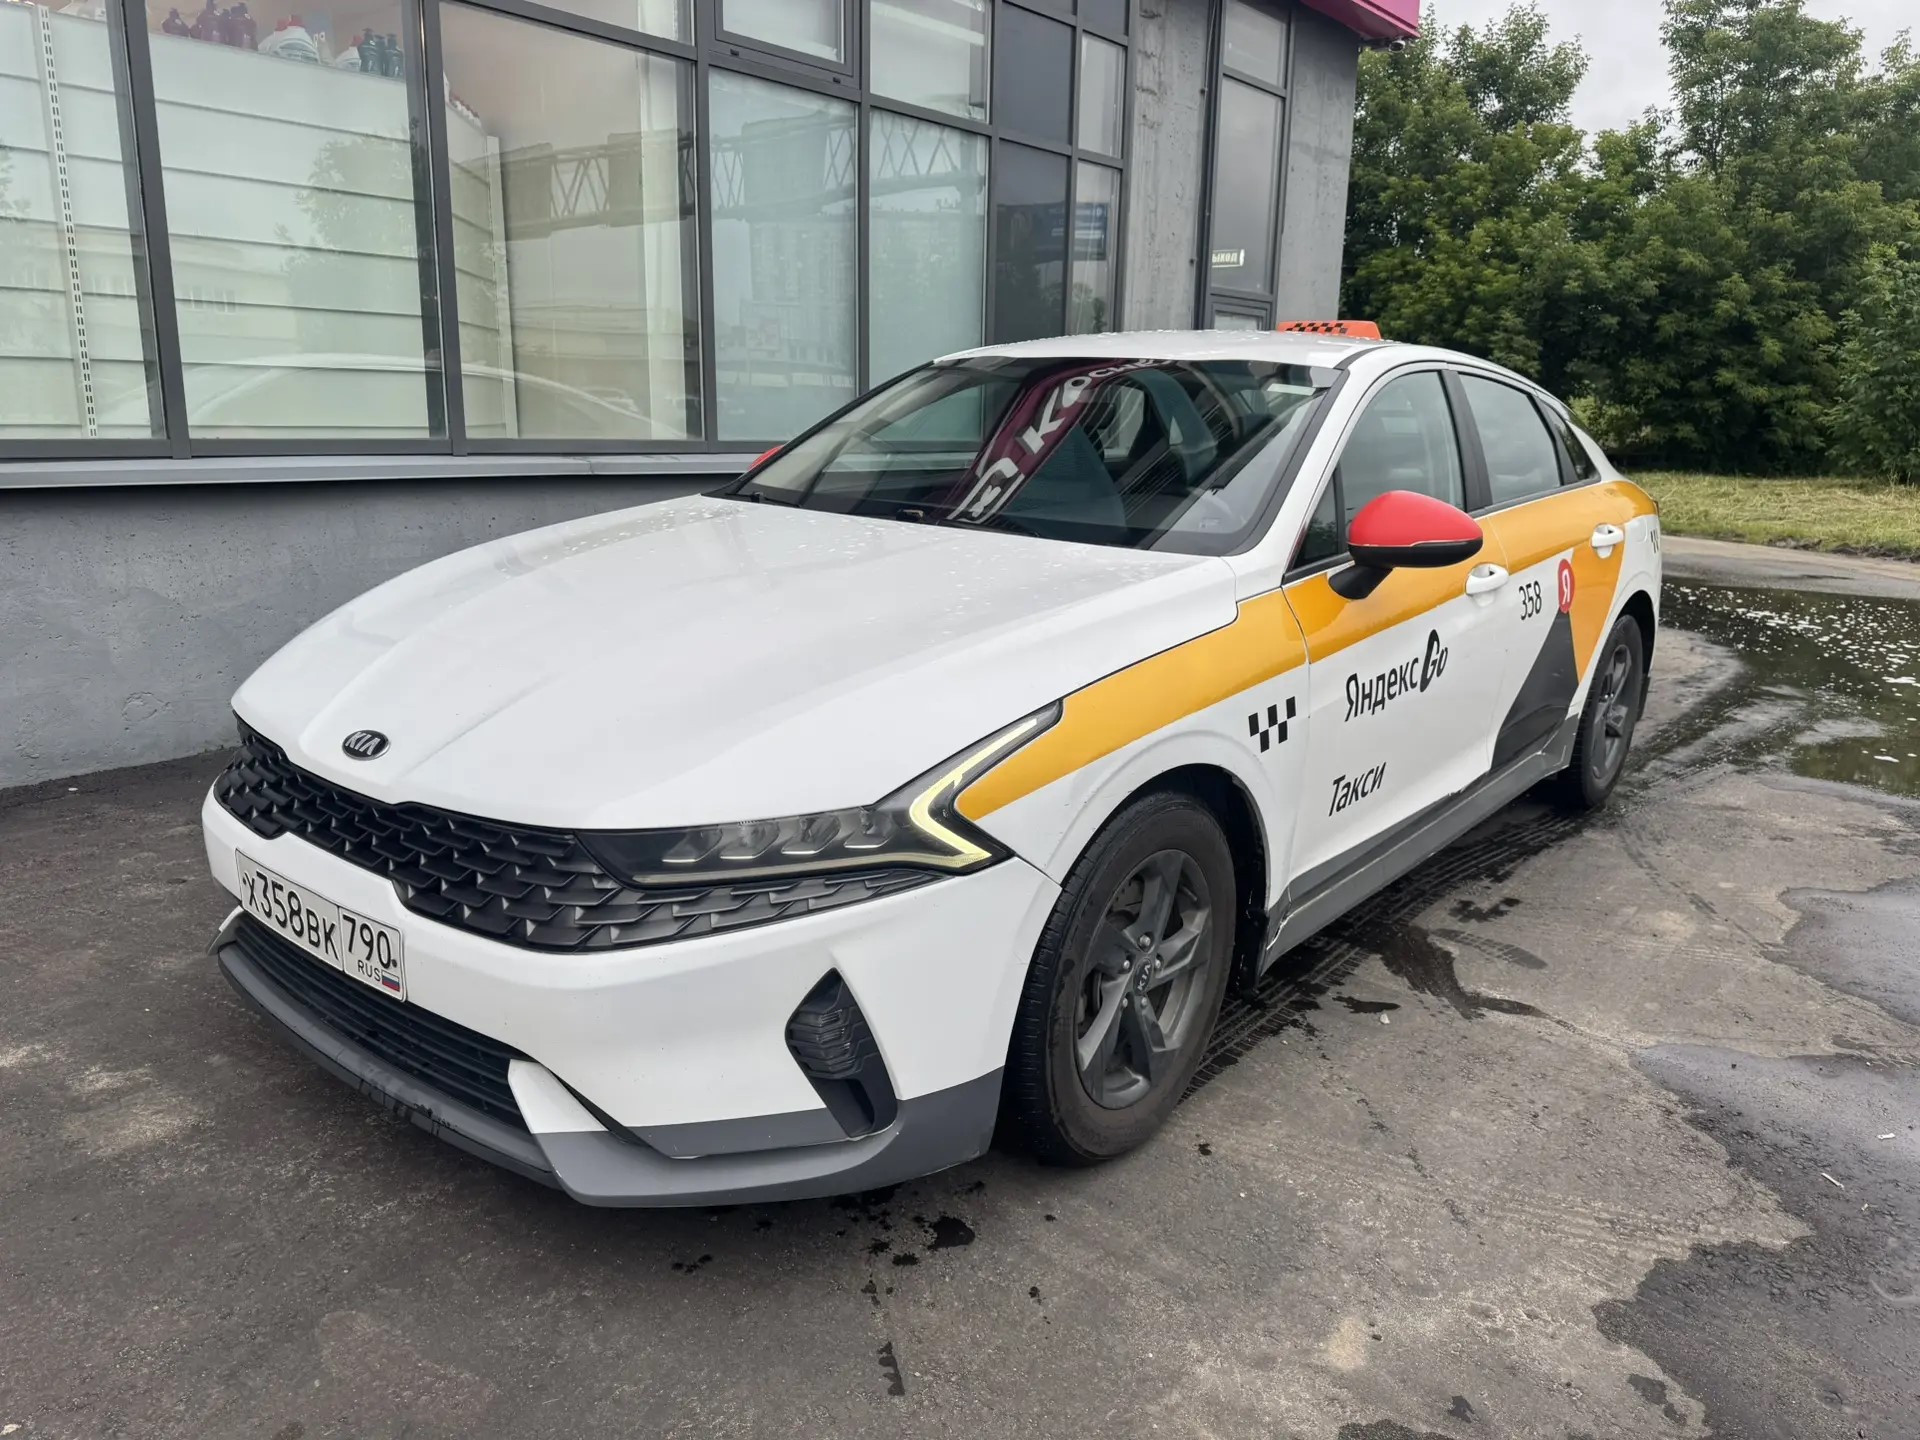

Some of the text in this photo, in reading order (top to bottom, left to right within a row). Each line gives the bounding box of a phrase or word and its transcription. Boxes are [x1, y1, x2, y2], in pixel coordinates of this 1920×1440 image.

[1211, 252, 1238, 263] ЫХОД
[1518, 580, 1543, 621] 358
[1343, 629, 1448, 723] Яндекс Go
[344, 731, 381, 756] KIA
[1328, 761, 1387, 818] Такси
[357, 959, 381, 982] RUS
[1136, 964, 1151, 991] KIA
